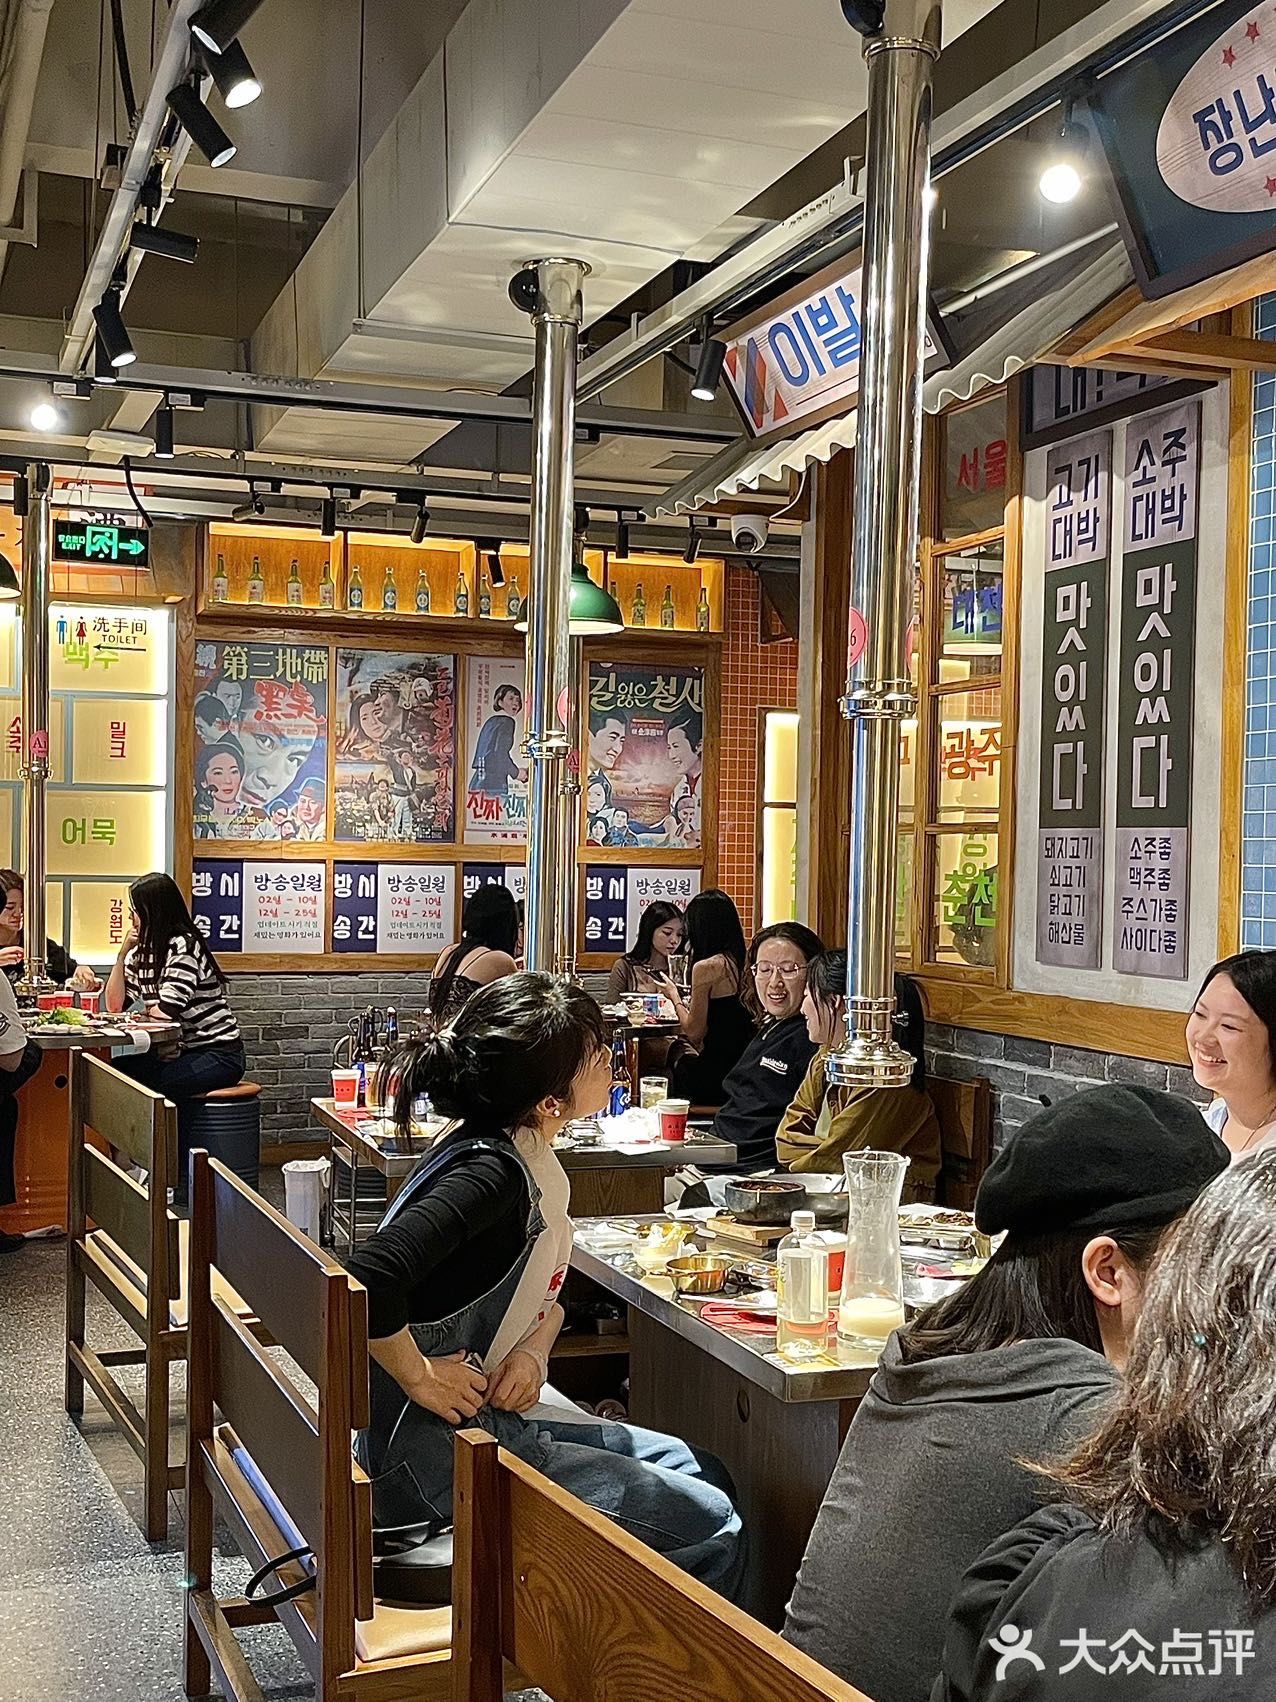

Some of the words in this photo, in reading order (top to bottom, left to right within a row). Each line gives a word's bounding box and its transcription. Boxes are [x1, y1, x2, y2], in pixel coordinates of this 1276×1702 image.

[1131, 427, 1187, 490] 소주
[1052, 453, 1099, 512] 고기
[1131, 483, 1188, 543] 대박
[1051, 506, 1100, 562] 대박
[93, 616, 147, 636] 洗手间
[101, 634, 138, 645] TOILET
[1052, 581, 1092, 811] 맛있다
[1131, 562, 1178, 809] 맛있다
[110, 721, 127, 759] 밀크
[61, 817, 118, 846] 어묵
[1044, 836, 1094, 860] 돼지고기
[254, 873, 323, 893] 방송일월
[387, 874, 447, 894] 방송일월
[636, 878, 692, 897] 방송일월
[1049, 864, 1086, 888] 쇠고기
[1049, 893, 1085, 917] 닭고기
[109, 898, 123, 945] 강원도
[1048, 920, 1085, 945] 해산물
